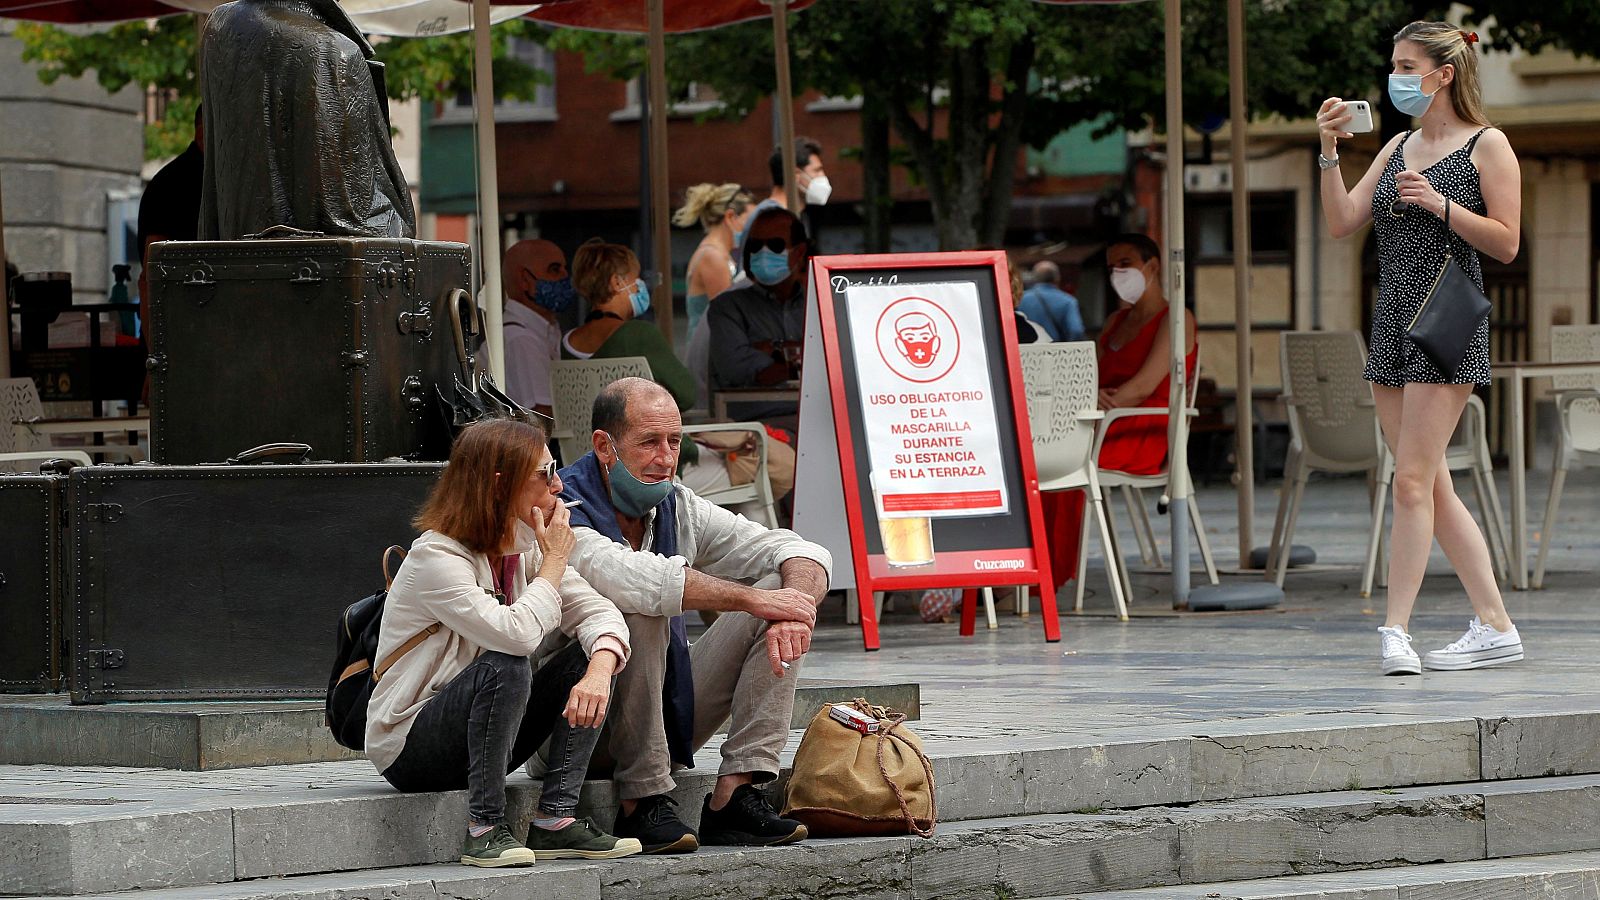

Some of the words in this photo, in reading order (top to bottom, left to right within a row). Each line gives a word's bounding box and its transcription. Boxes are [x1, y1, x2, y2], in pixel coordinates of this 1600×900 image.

[870, 394, 896, 405] USO
[899, 390, 984, 405] OBLIGATORIO
[910, 408, 929, 419] DE
[931, 407, 947, 418] LA
[891, 421, 972, 434] MASCARILLA
[903, 436, 964, 449] DURANTE
[895, 453, 912, 465] SU
[915, 451, 976, 464] ESTANCIA
[889, 469, 907, 479] EN
[909, 468, 926, 479] LA
[927, 466, 986, 478] TERRAZA
[974, 559, 1025, 570] Cruzcampo
